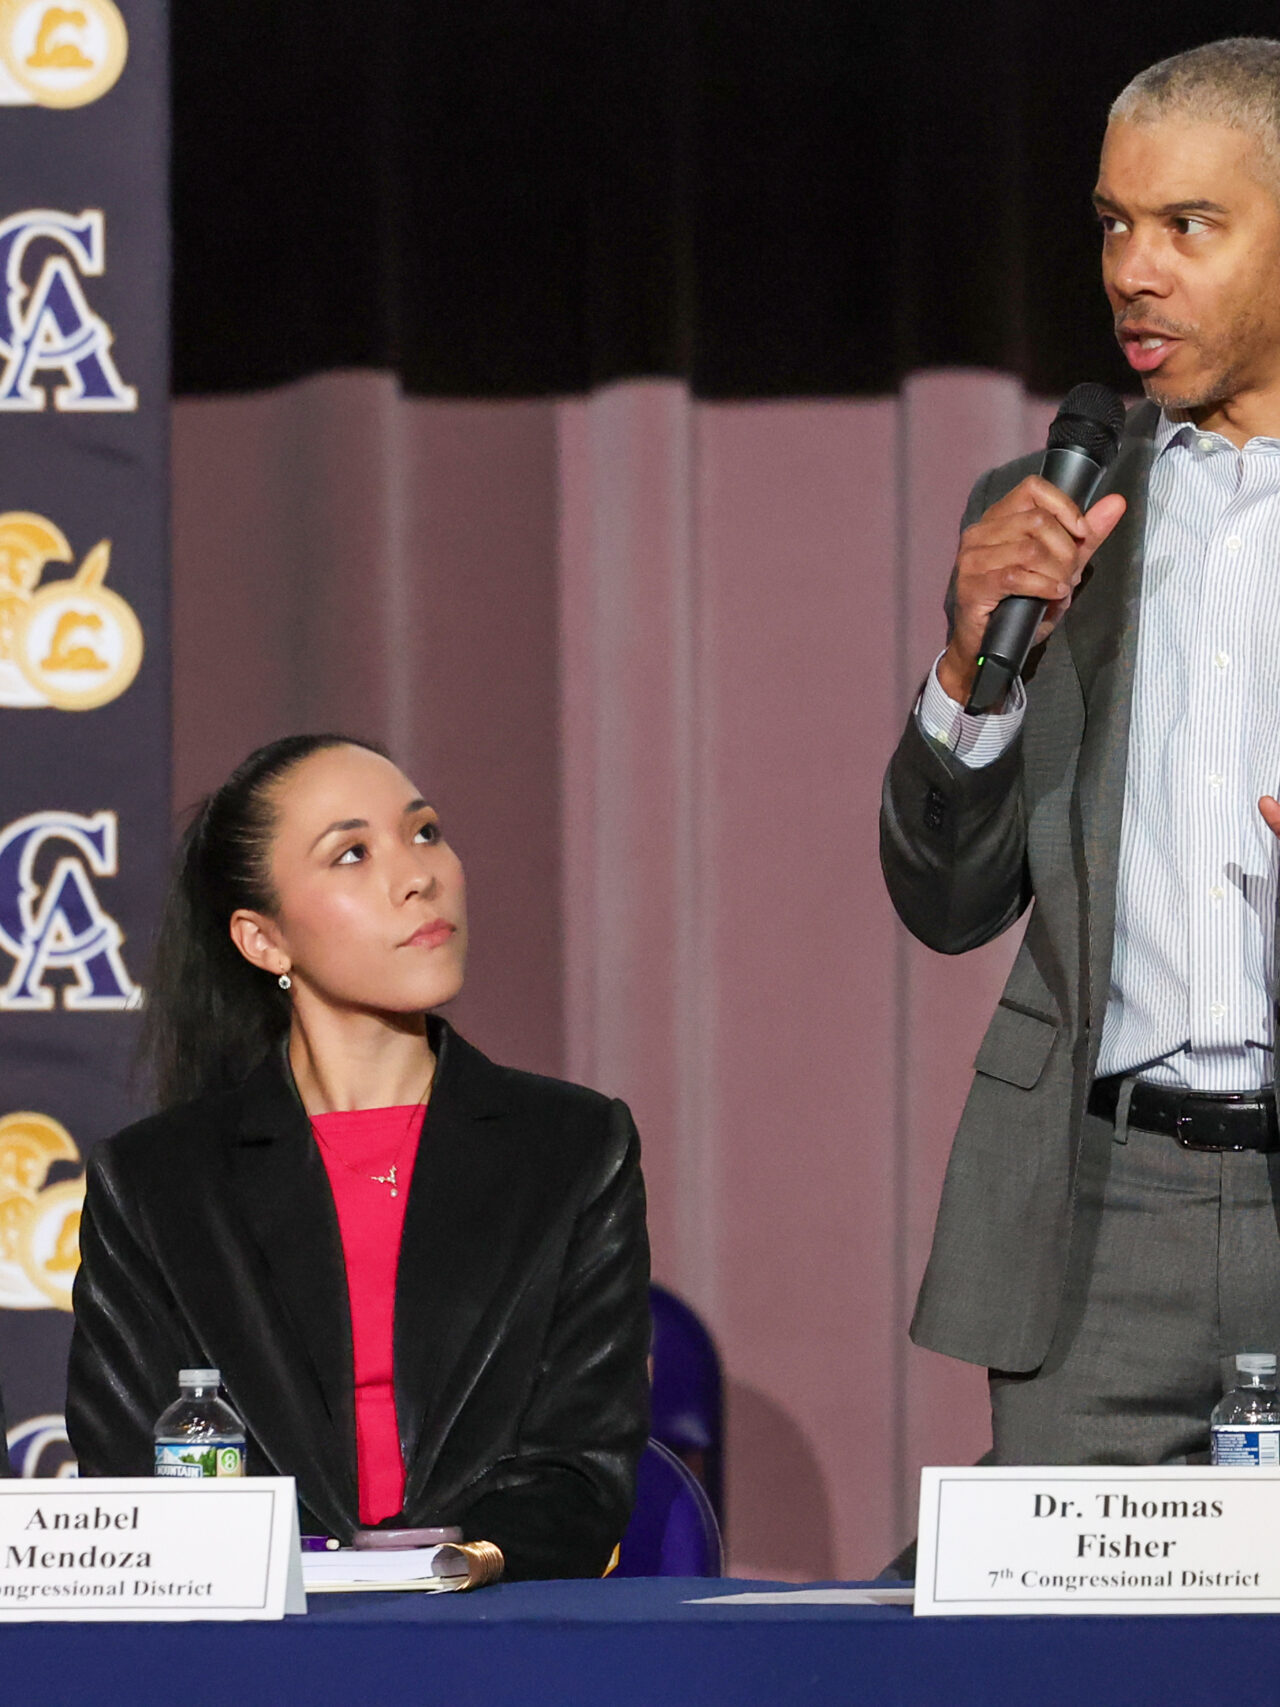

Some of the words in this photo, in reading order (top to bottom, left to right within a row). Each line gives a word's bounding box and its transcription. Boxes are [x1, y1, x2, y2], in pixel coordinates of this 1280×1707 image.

[1034, 1494, 1082, 1518] Dr.
[1096, 1495, 1223, 1518] Thomas
[26, 1507, 138, 1529] Anabel
[7, 1546, 150, 1568] Mendoza
[1077, 1534, 1176, 1558] Fisher
[0, 1580, 125, 1600] ngressional
[134, 1581, 211, 1595] District
[1021, 1571, 1172, 1591] Congressional
[1181, 1570, 1259, 1586] District
